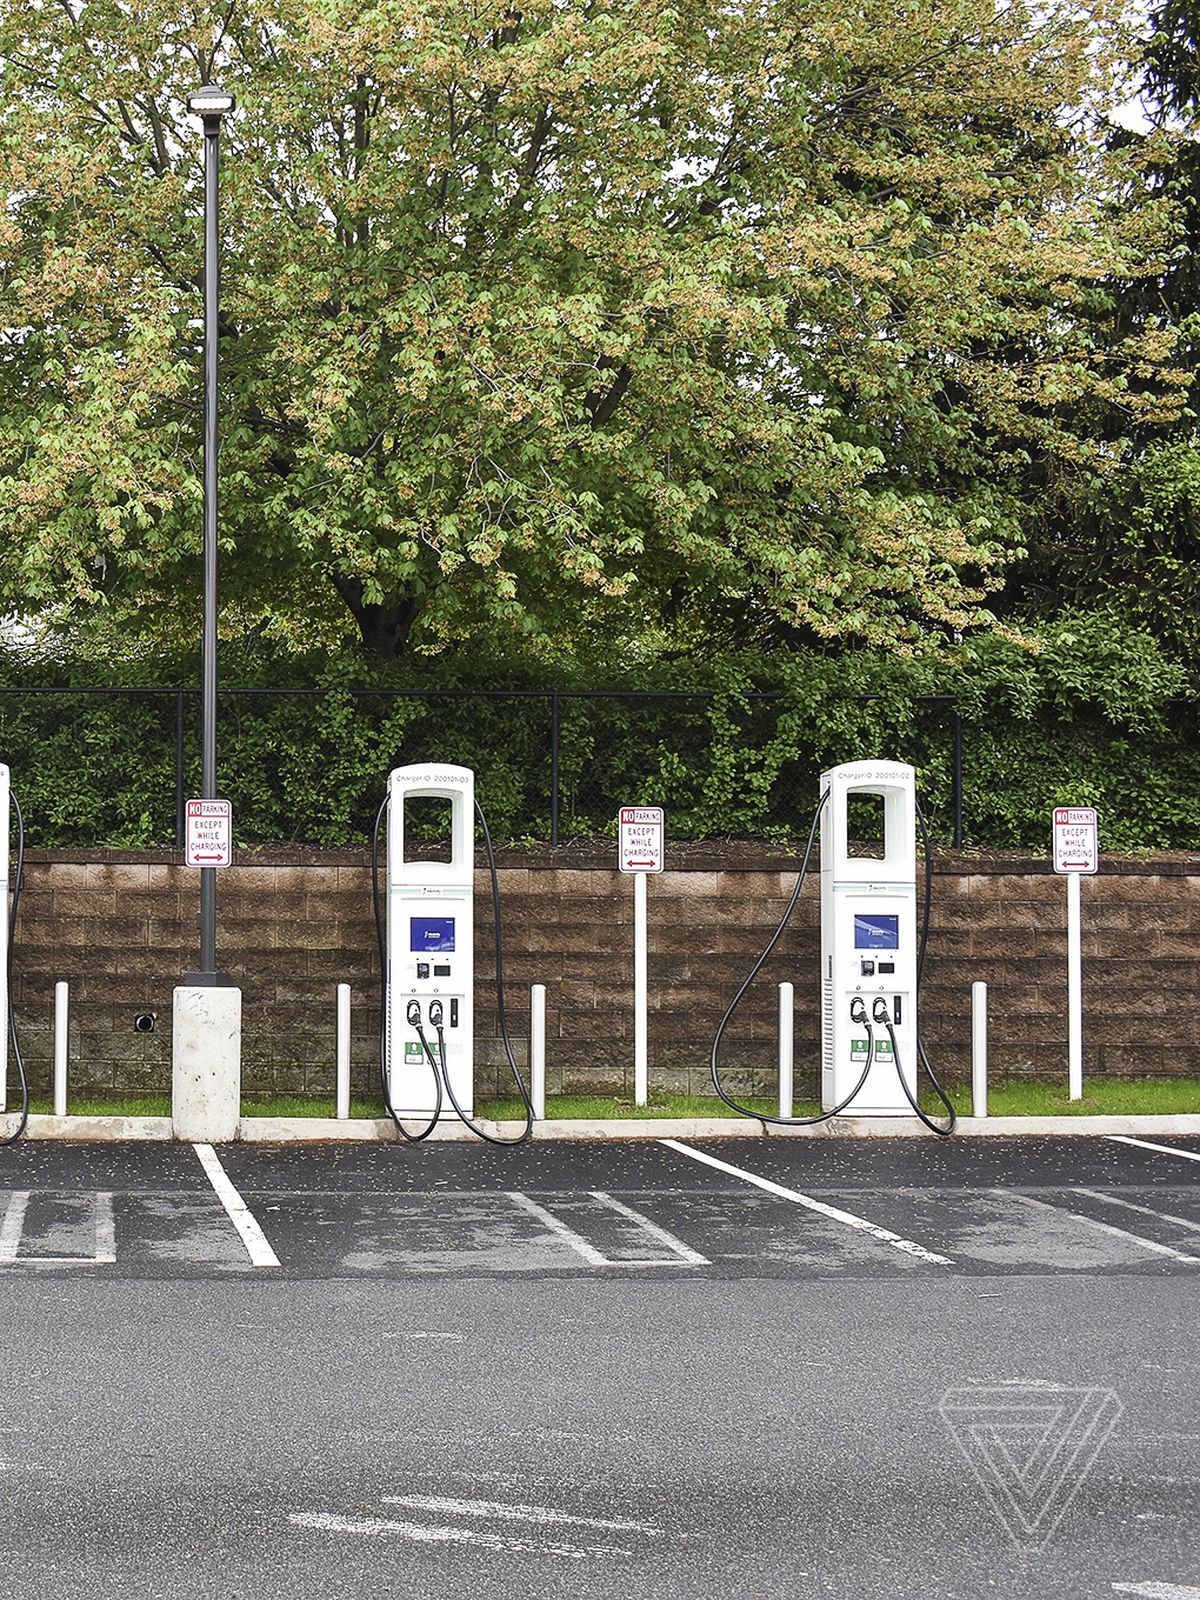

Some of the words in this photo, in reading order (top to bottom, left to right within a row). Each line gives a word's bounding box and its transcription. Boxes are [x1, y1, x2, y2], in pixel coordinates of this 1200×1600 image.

[190, 804, 200, 814] NO
[202, 804, 227, 814] PARKING
[623, 810, 634, 822] NO
[636, 812, 660, 820] PARKING
[1056, 811, 1068, 822] NO
[1069, 812, 1092, 822] PARKING
[194, 820, 222, 829] EXCEPT
[197, 832, 219, 840] WHILE
[628, 828, 654, 836] EXCEPT
[1062, 828, 1088, 837] EXCEPT
[190, 842, 226, 851] CHARGING
[630, 838, 652, 847] WHILE
[1064, 838, 1086, 848] WHILE
[624, 848, 658, 857] CHARGING
[1058, 849, 1092, 858] CHARGING
